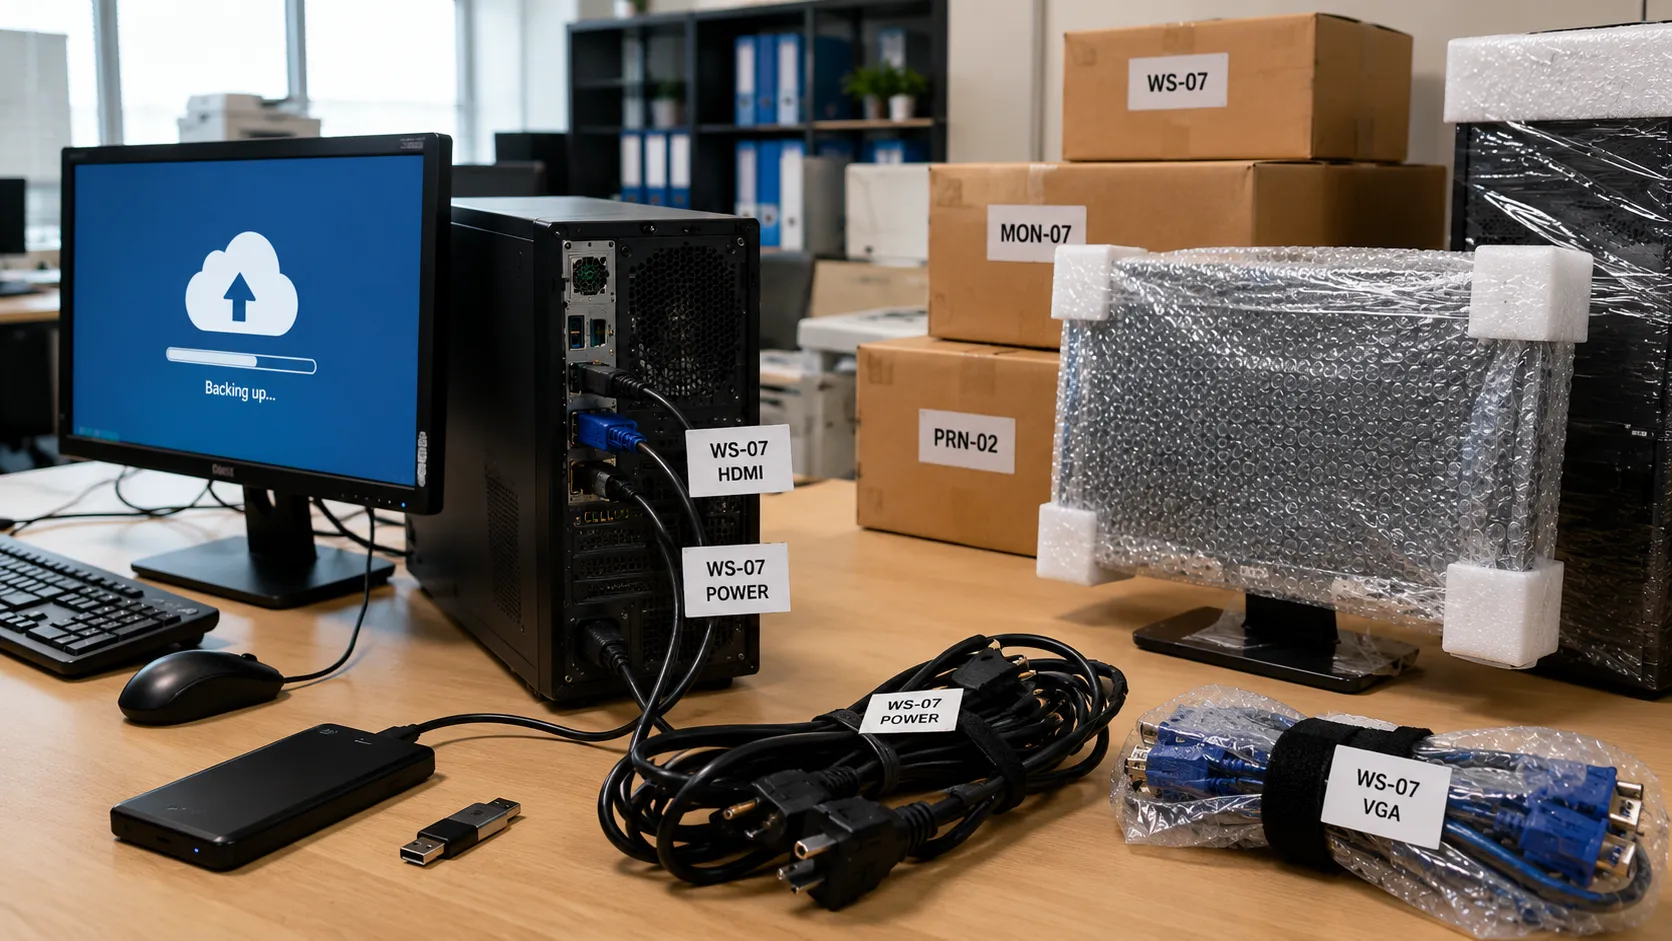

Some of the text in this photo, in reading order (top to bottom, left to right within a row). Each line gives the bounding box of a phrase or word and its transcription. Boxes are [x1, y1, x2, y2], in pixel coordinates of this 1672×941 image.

[1147, 71, 1209, 93] WS-07
[1000, 223, 1072, 244] MON-07
[205, 379, 276, 404] Backing up...
[709, 440, 769, 459] WS-07
[934, 427, 998, 454] PRN-02
[718, 464, 764, 482] HDMI
[706, 559, 766, 578] WS-07
[706, 584, 770, 602] POWER
[888, 698, 943, 711] WS-07
[880, 713, 940, 726] POWER
[1357, 768, 1421, 798] WS-07
[1363, 797, 1401, 822] VGA
